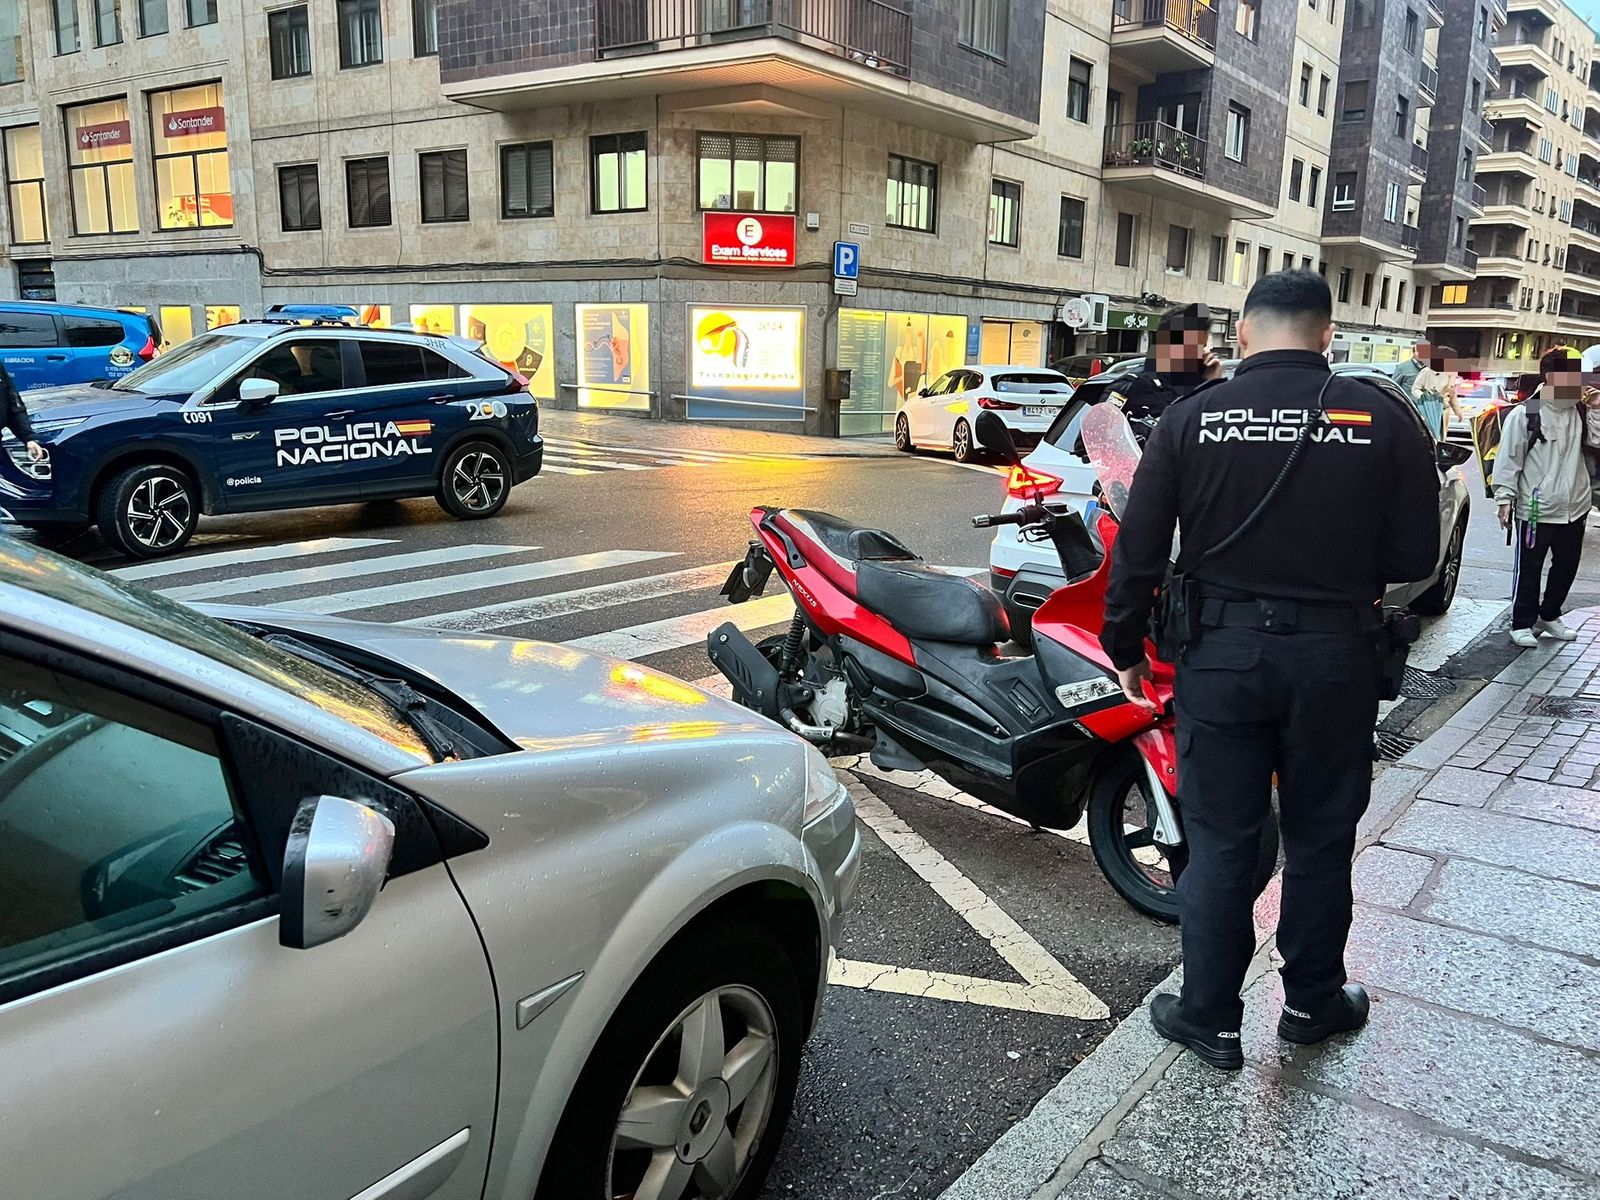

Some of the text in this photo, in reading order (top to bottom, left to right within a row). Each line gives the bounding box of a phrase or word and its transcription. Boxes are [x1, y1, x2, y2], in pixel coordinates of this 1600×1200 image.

[177, 116, 213, 129] Santander
[89, 129, 120, 141] Santander
[745, 225, 754, 237] E
[711, 244, 787, 257] Exam Services
[839, 247, 854, 275] P
[763, 372, 795, 380] Punta
[1201, 408, 1331, 426] POLICIA
[274, 421, 401, 447] POLICIA
[1199, 426, 1372, 444] NACIONAL
[277, 438, 433, 467] NACIONAL
[226, 476, 262, 487] @policia
[791, 579, 817, 607] NEXUS
